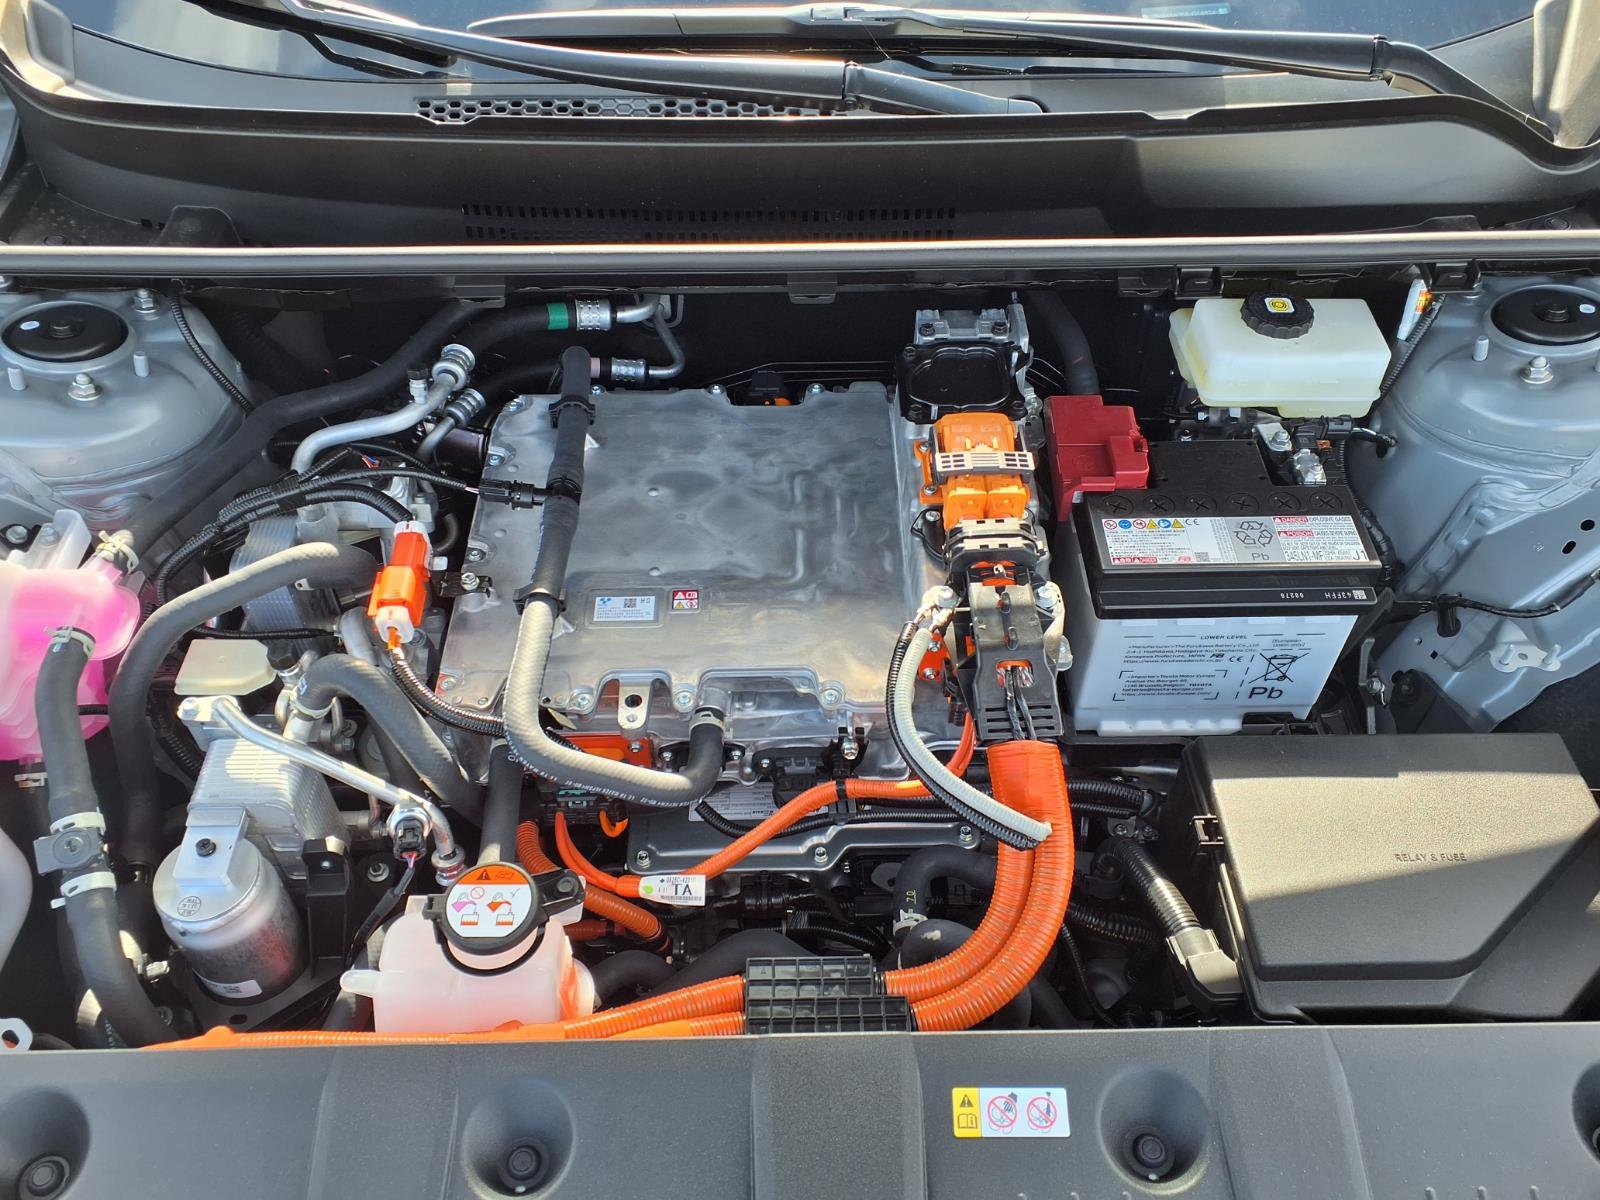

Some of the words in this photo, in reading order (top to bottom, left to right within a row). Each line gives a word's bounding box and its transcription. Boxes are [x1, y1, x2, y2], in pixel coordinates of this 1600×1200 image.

[1251, 552, 1270, 561] Pb
[1247, 686, 1284, 699] Pb
[1393, 853, 1426, 862] RELAY
[1440, 852, 1468, 862] FUSE
[672, 883, 693, 896] TA
